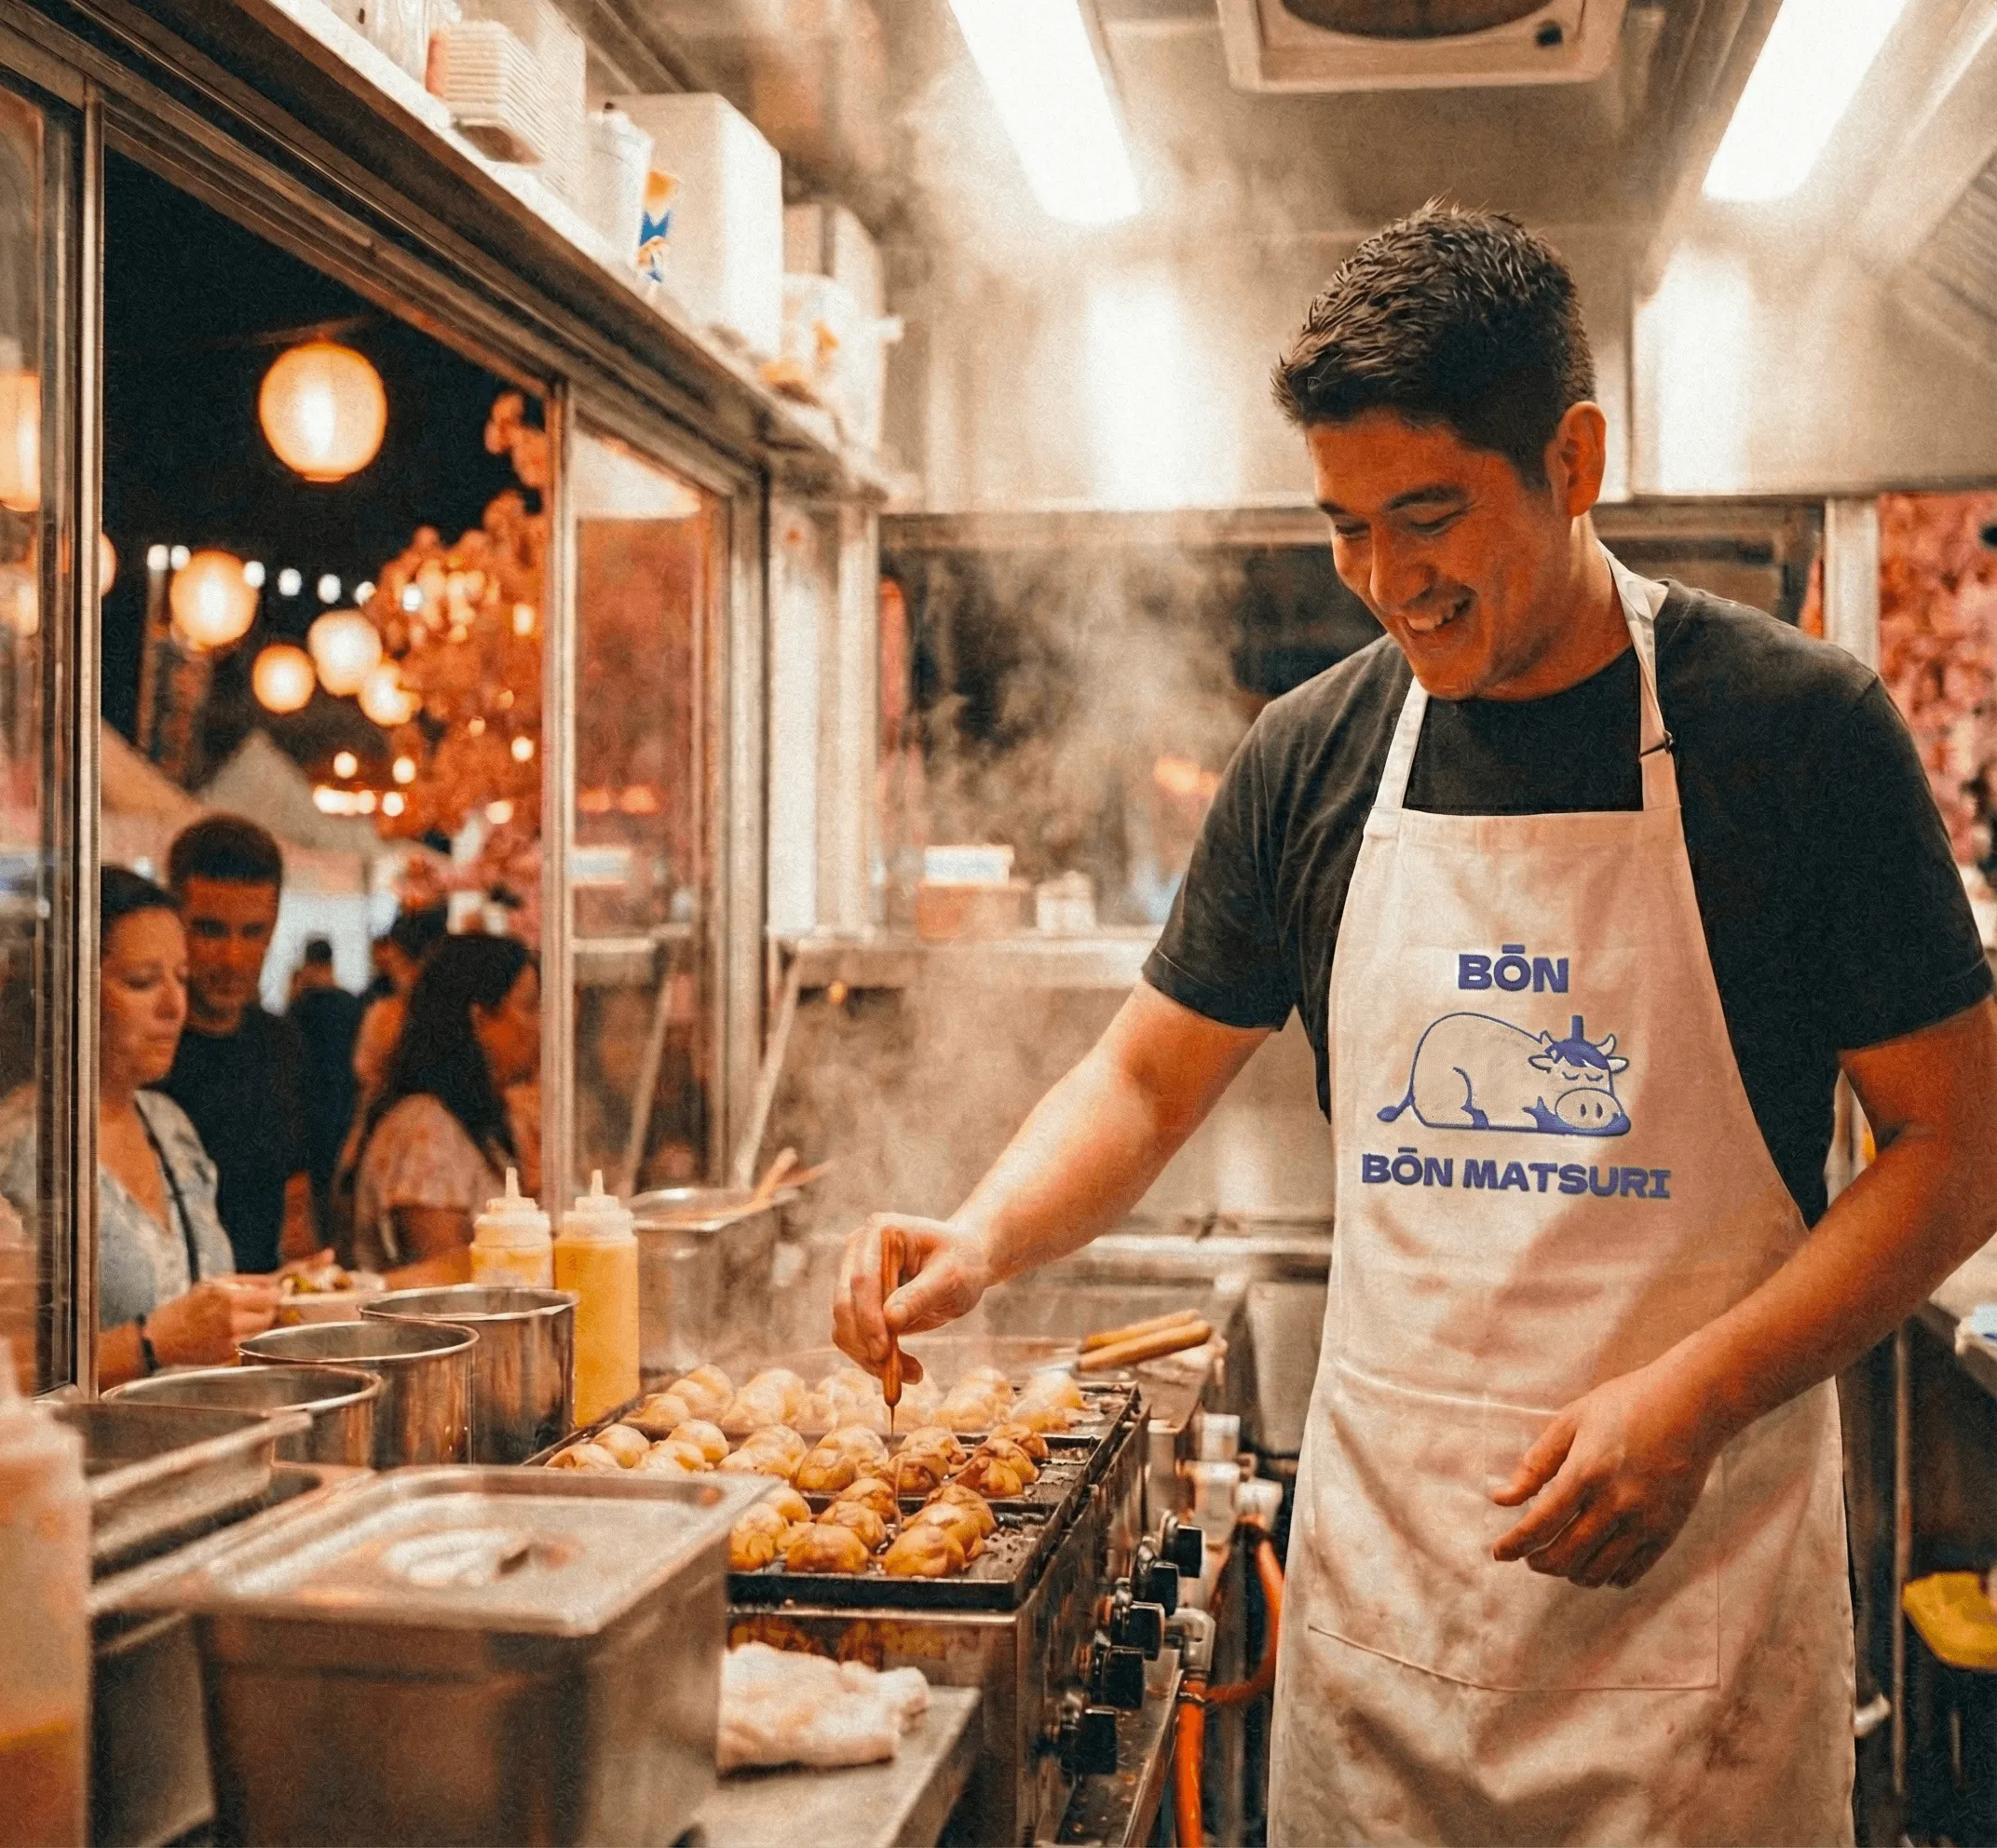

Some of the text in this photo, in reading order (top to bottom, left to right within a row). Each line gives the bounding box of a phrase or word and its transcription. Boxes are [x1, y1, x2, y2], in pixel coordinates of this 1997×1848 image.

[1458, 944, 1569, 993] BŌN
[1362, 1147, 1672, 1199] BŌN MATSURI
